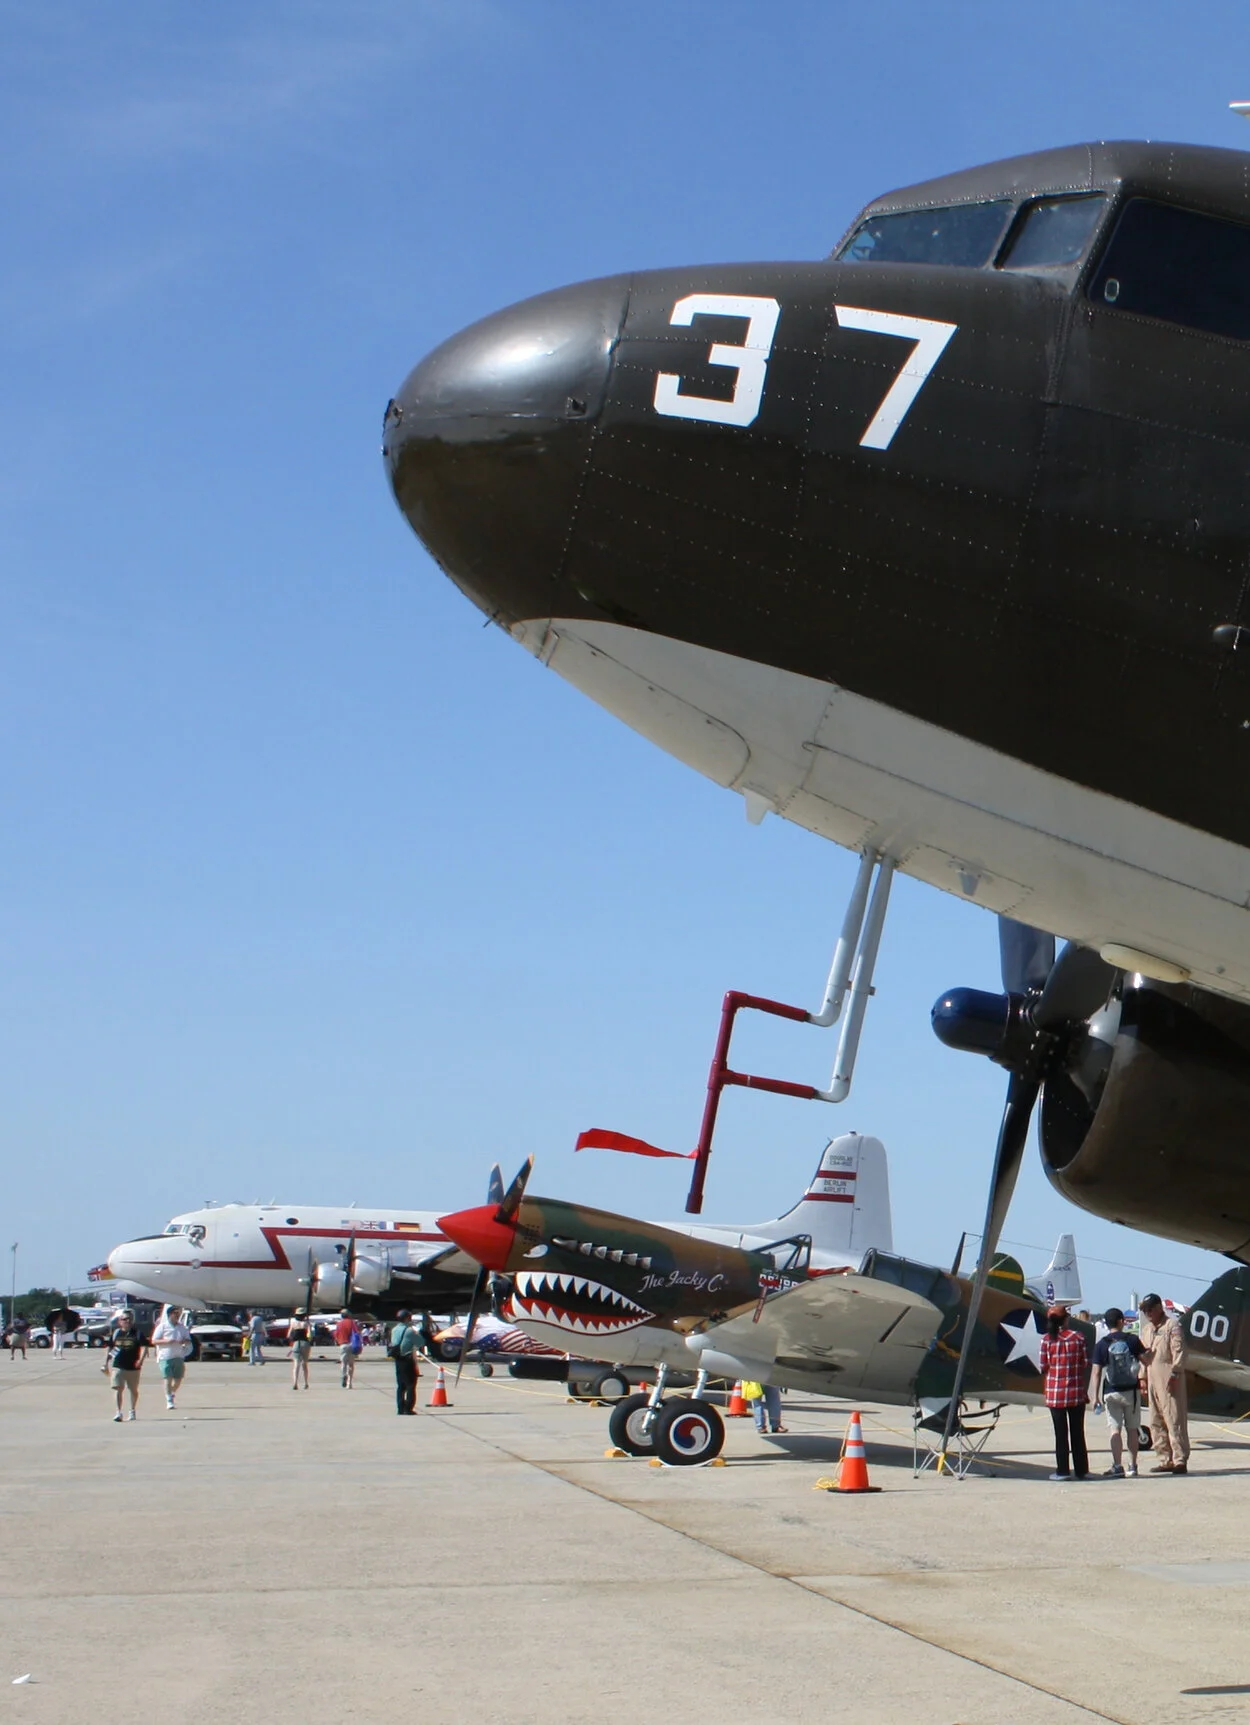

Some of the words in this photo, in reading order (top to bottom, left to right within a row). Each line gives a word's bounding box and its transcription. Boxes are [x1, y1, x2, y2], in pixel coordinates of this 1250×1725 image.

[653, 293, 958, 450] 37
[637, 1273, 666, 1293] The
[1190, 1310, 1229, 1343] 00
